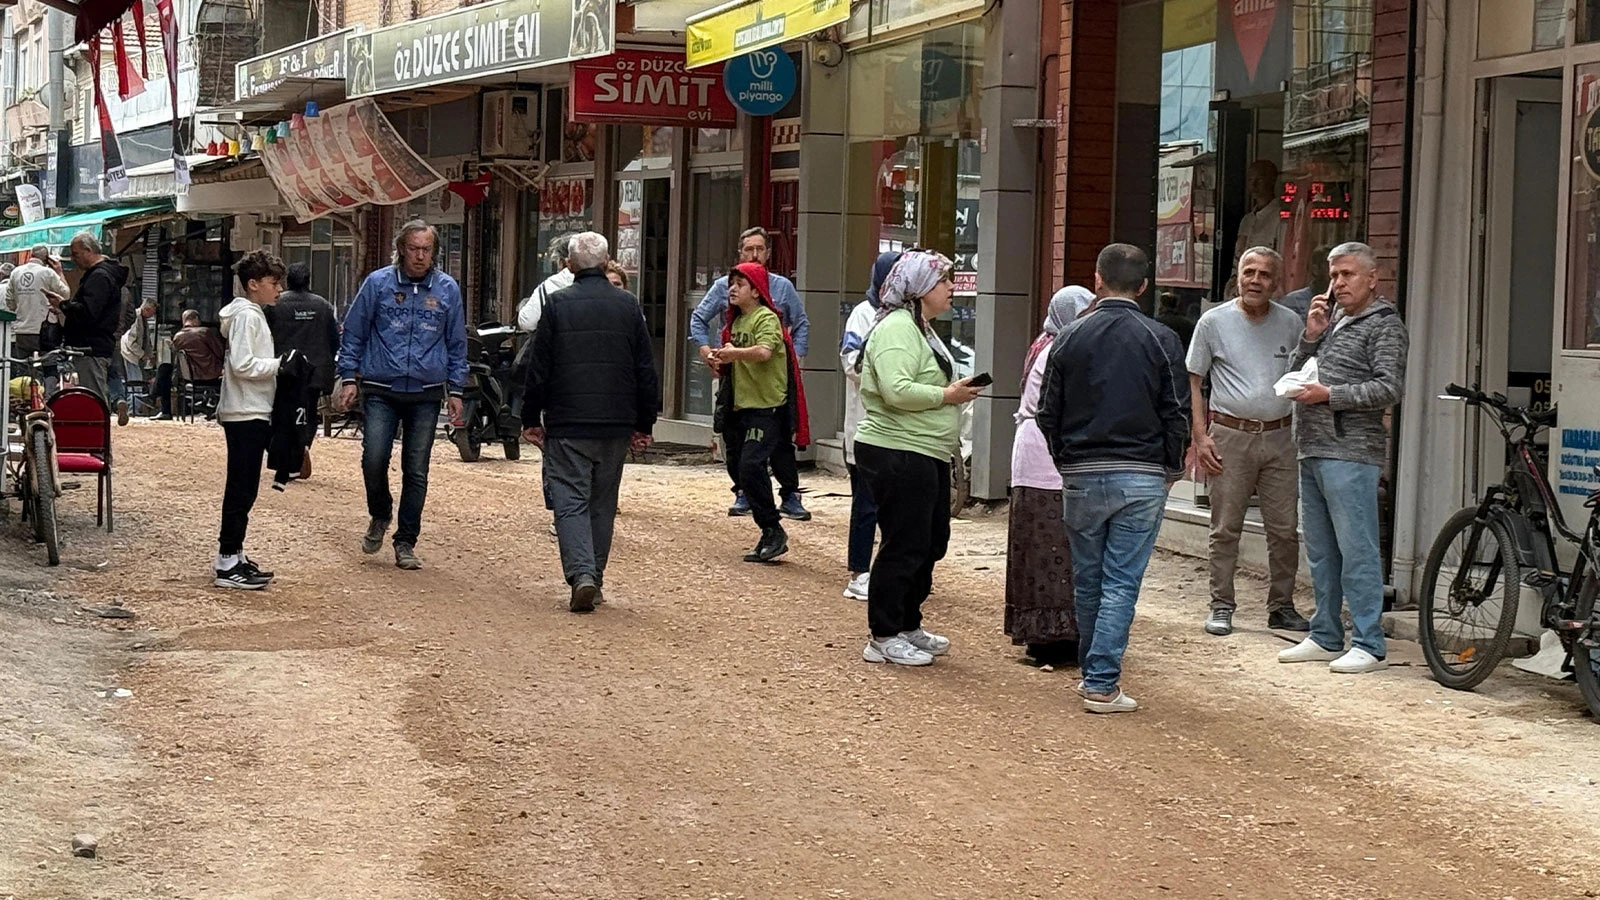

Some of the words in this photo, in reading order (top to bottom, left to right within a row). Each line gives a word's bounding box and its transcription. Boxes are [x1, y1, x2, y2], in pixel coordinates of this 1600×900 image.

[394, 42, 411, 82] ÖZ
[413, 24, 460, 79] DÜZCE
[738, 85, 783, 104] piyango
[750, 81, 772, 92] milli
[687, 107, 712, 121] evi
